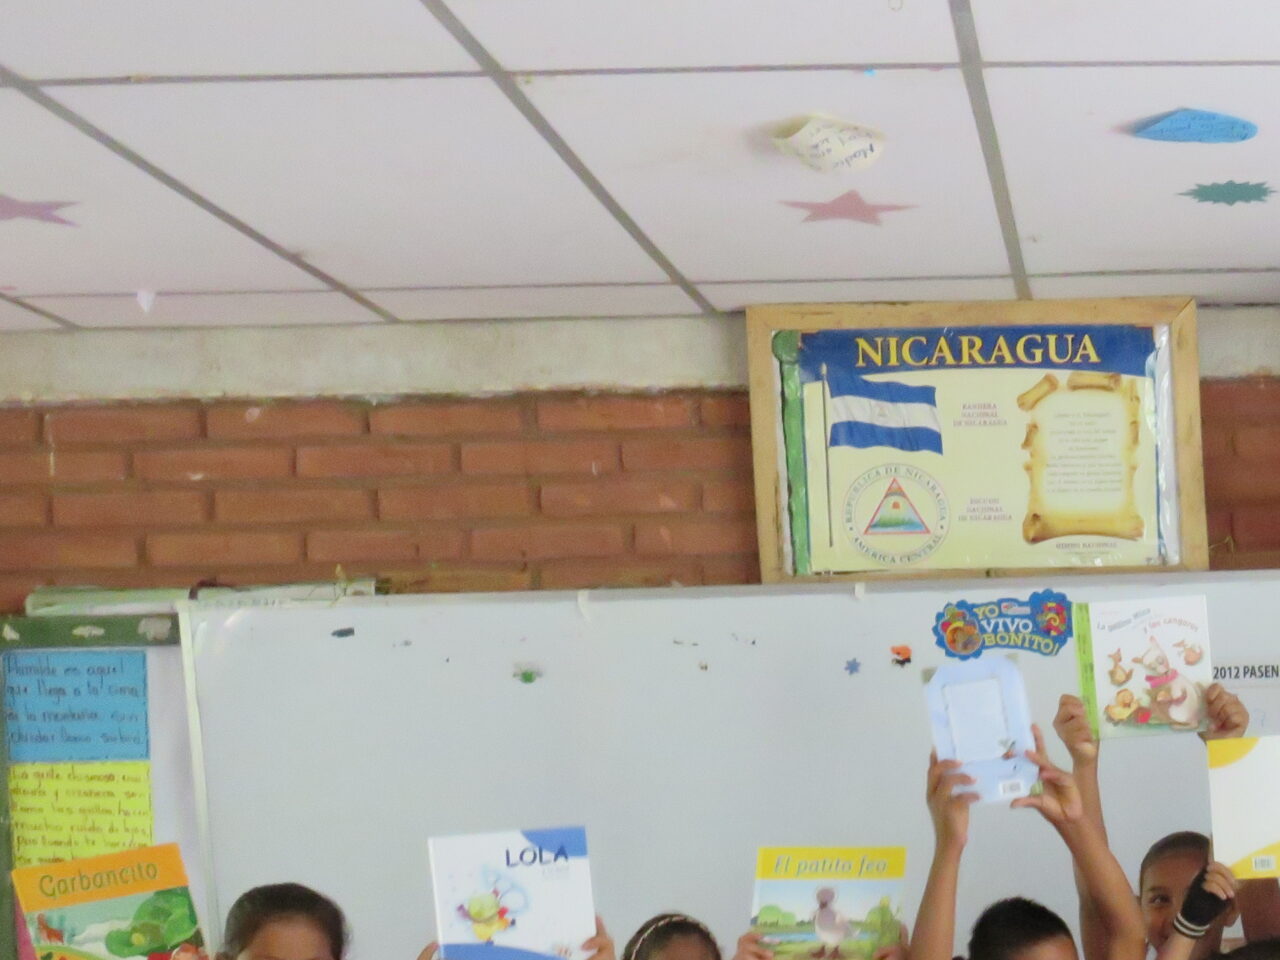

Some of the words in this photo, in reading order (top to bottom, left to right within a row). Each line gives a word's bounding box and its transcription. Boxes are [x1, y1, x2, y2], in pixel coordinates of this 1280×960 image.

[855, 333, 1101, 367] NICARAGUA
[885, 466, 900, 475] DE
[906, 467, 947, 521] NICARAGUA
[853, 536, 896, 564] AMERICA
[900, 534, 943, 563] CENTRAL
[973, 604, 999, 619] YO
[981, 618, 1033, 633] VIVO
[983, 632, 1060, 656] BONITO!
[1213, 666, 1240, 679] 2012
[1243, 665, 1279, 679] PASEN
[506, 845, 569, 868] LOLA
[774, 855, 791, 873] El
[796, 858, 852, 877] patito
[858, 854, 889, 877] feo
[39, 862, 159, 899] Garbancito
